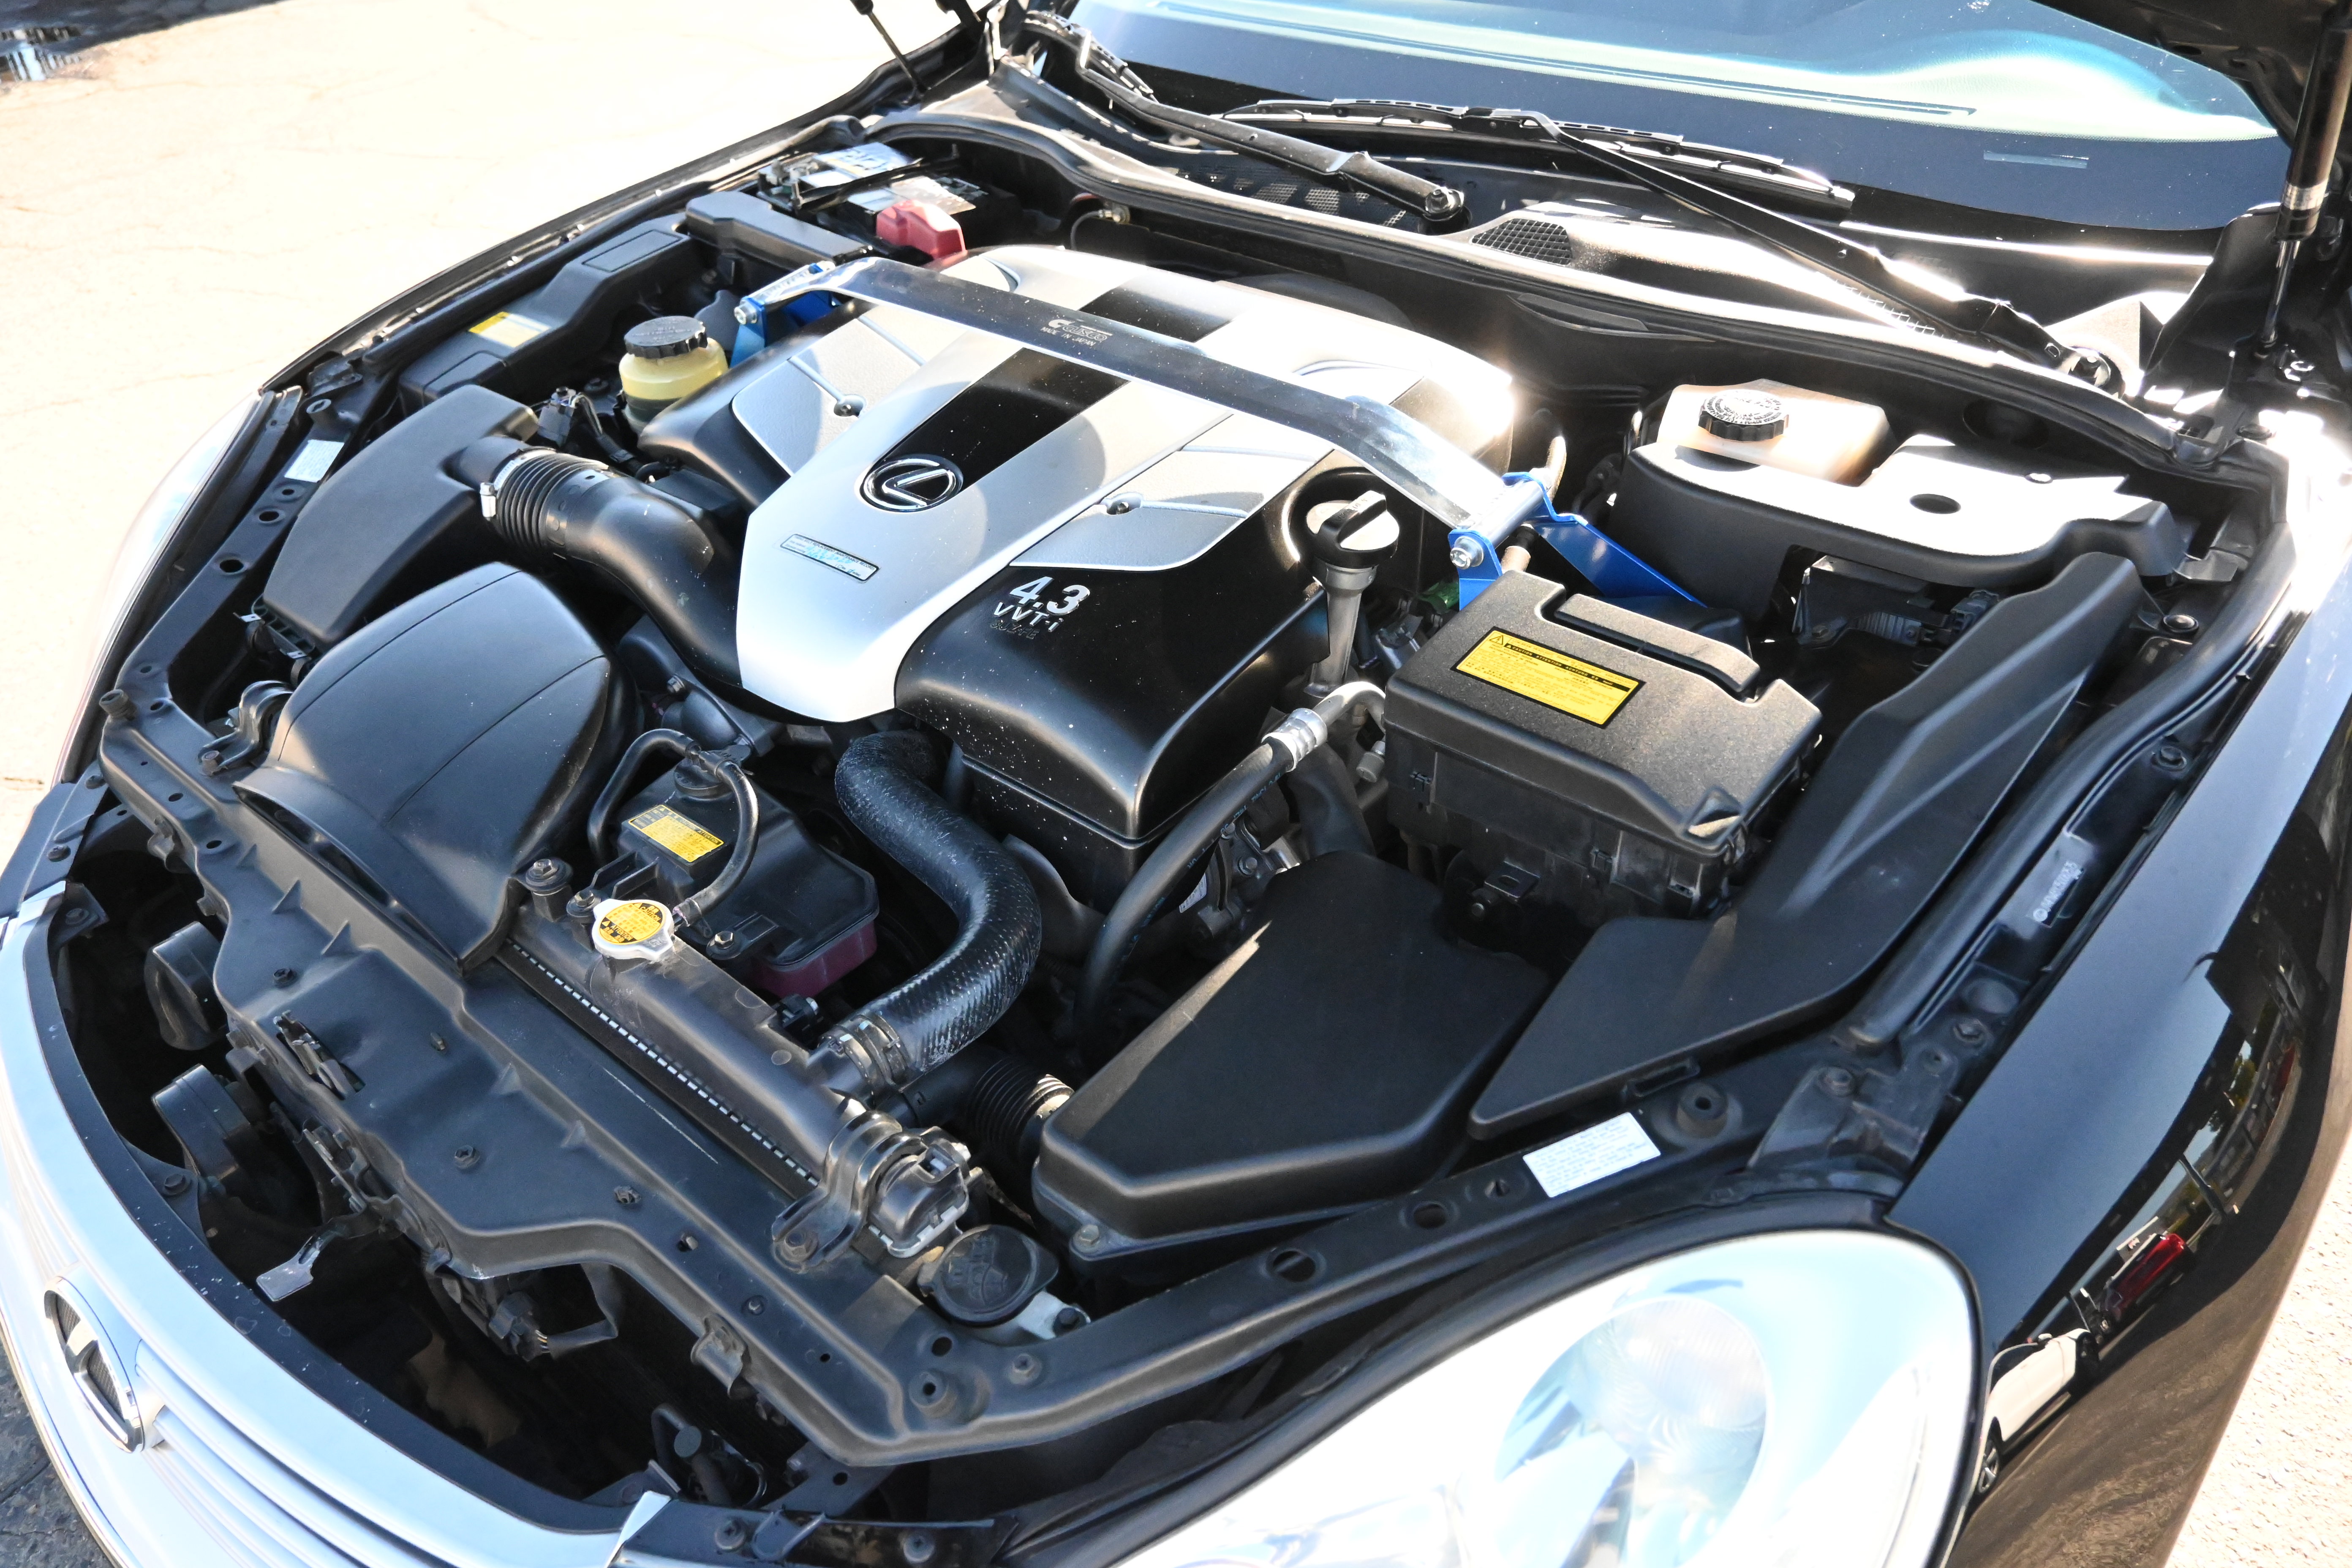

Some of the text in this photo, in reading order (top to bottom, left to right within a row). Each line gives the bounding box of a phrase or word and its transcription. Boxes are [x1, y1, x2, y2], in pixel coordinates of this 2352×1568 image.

[1040, 327, 1060, 335] MADE
[1072, 337, 1096, 346] JAPAN
[1009, 576, 1090, 615] 4.3
[994, 602, 1064, 632] VVT-i
[990, 619, 1040, 640] 3UZ-FE
[1512, 646, 1533, 656] CAUTION
[1536, 655, 1562, 667] ATTENTION
[1565, 666, 1589, 676] ACHTUNG
[697, 830, 719, 844] ATTENTION
[640, 906, 662, 922] CAUTION
[610, 924, 634, 941] ATTENTION
